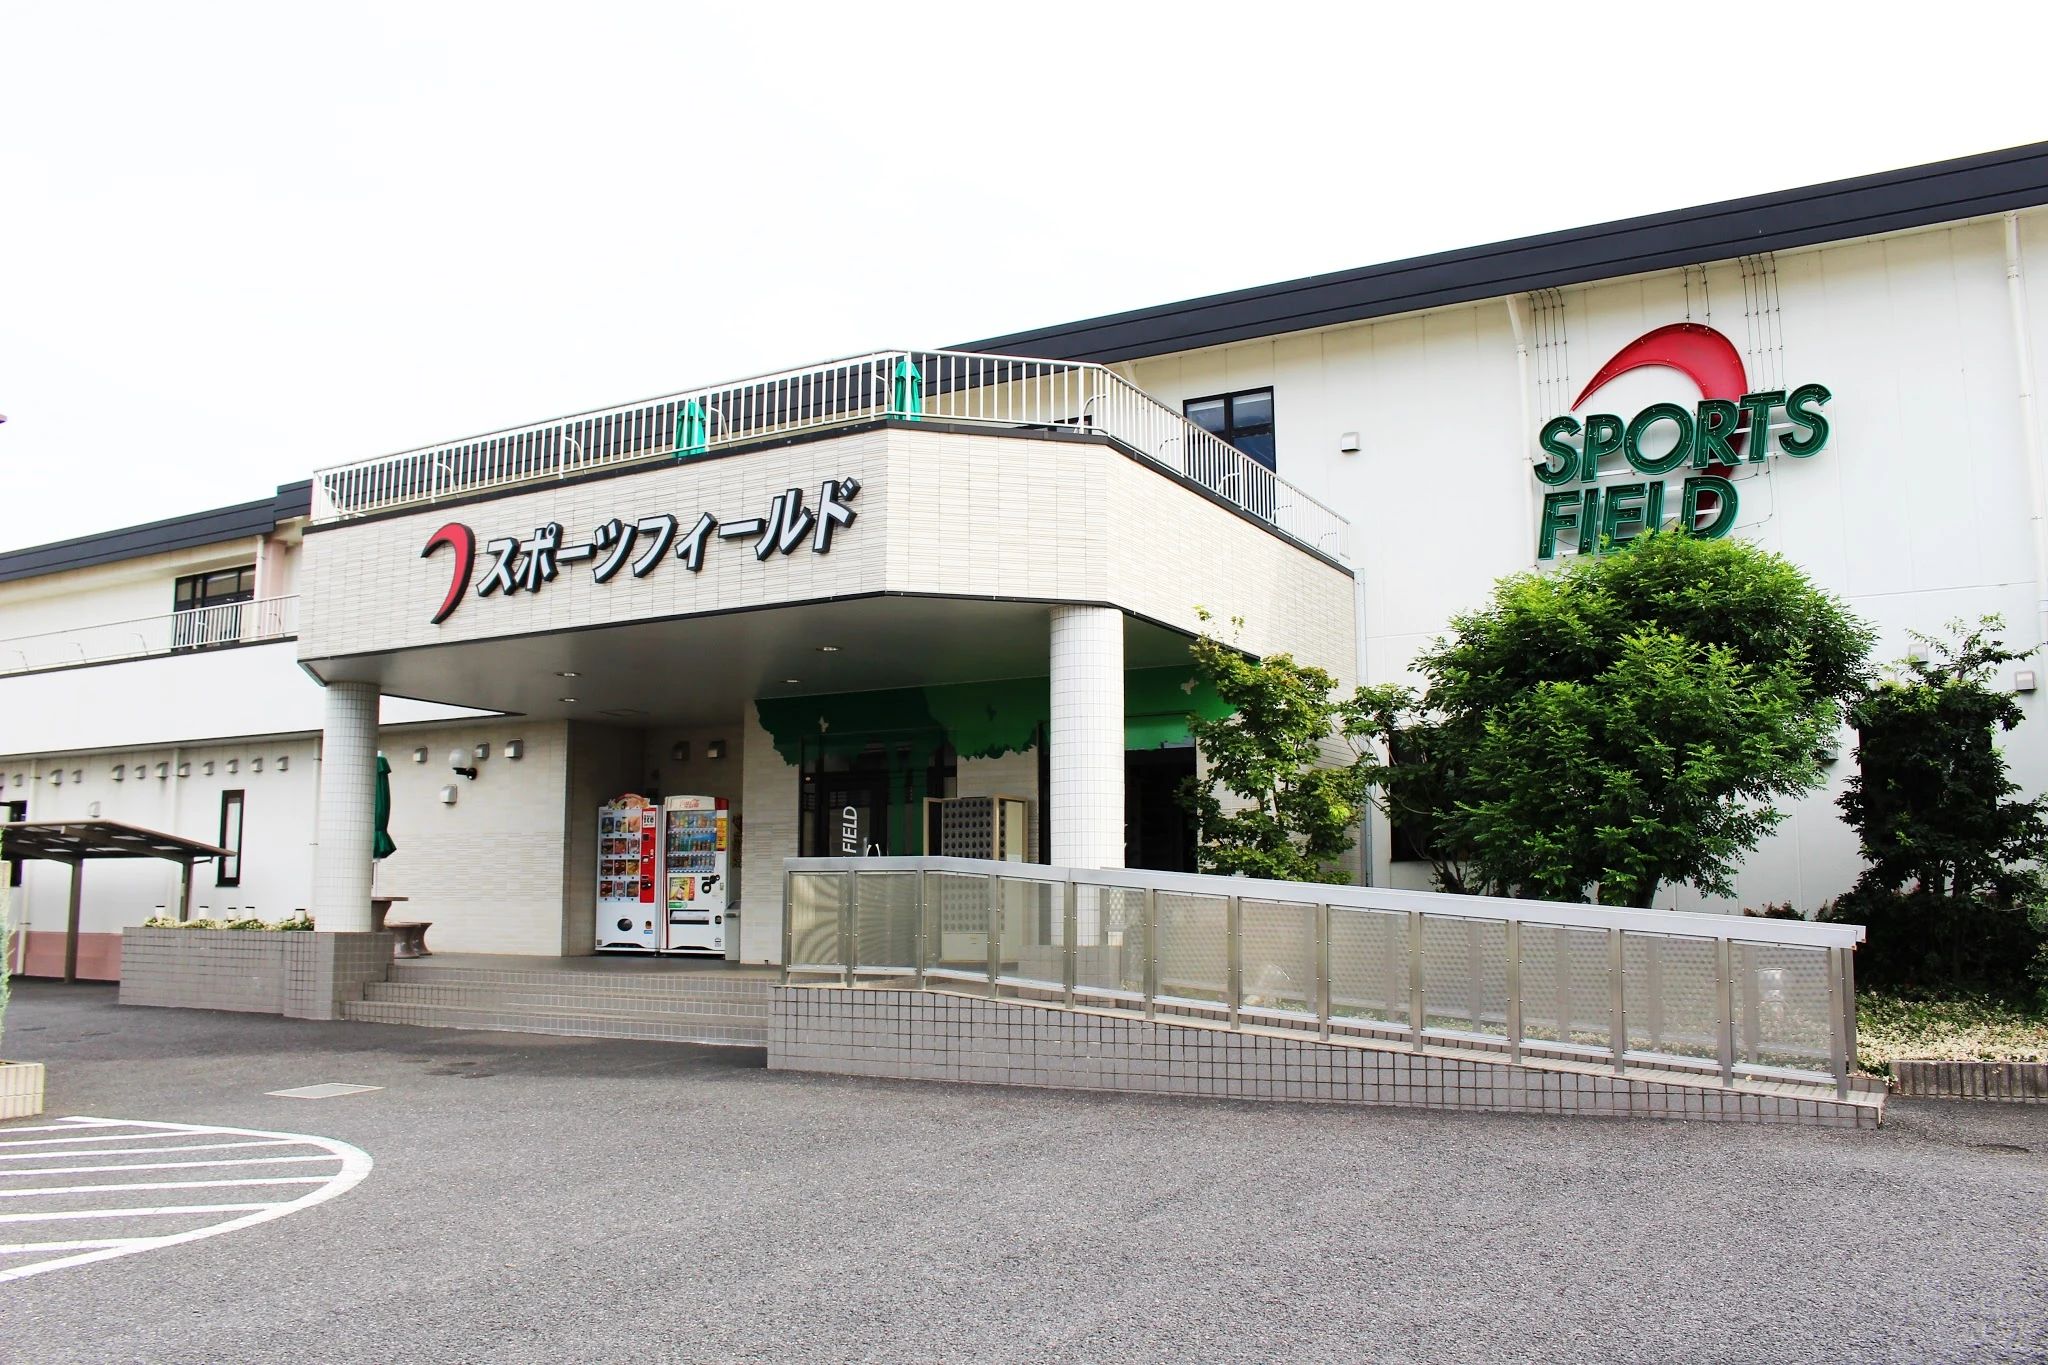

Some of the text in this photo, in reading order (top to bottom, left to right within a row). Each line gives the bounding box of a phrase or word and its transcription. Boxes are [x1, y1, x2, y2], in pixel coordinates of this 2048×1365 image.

[1533, 383, 1832, 486] SPORTS
[476, 477, 861, 597] スポーツフィールド
[842, 805, 858, 854] FIELD
